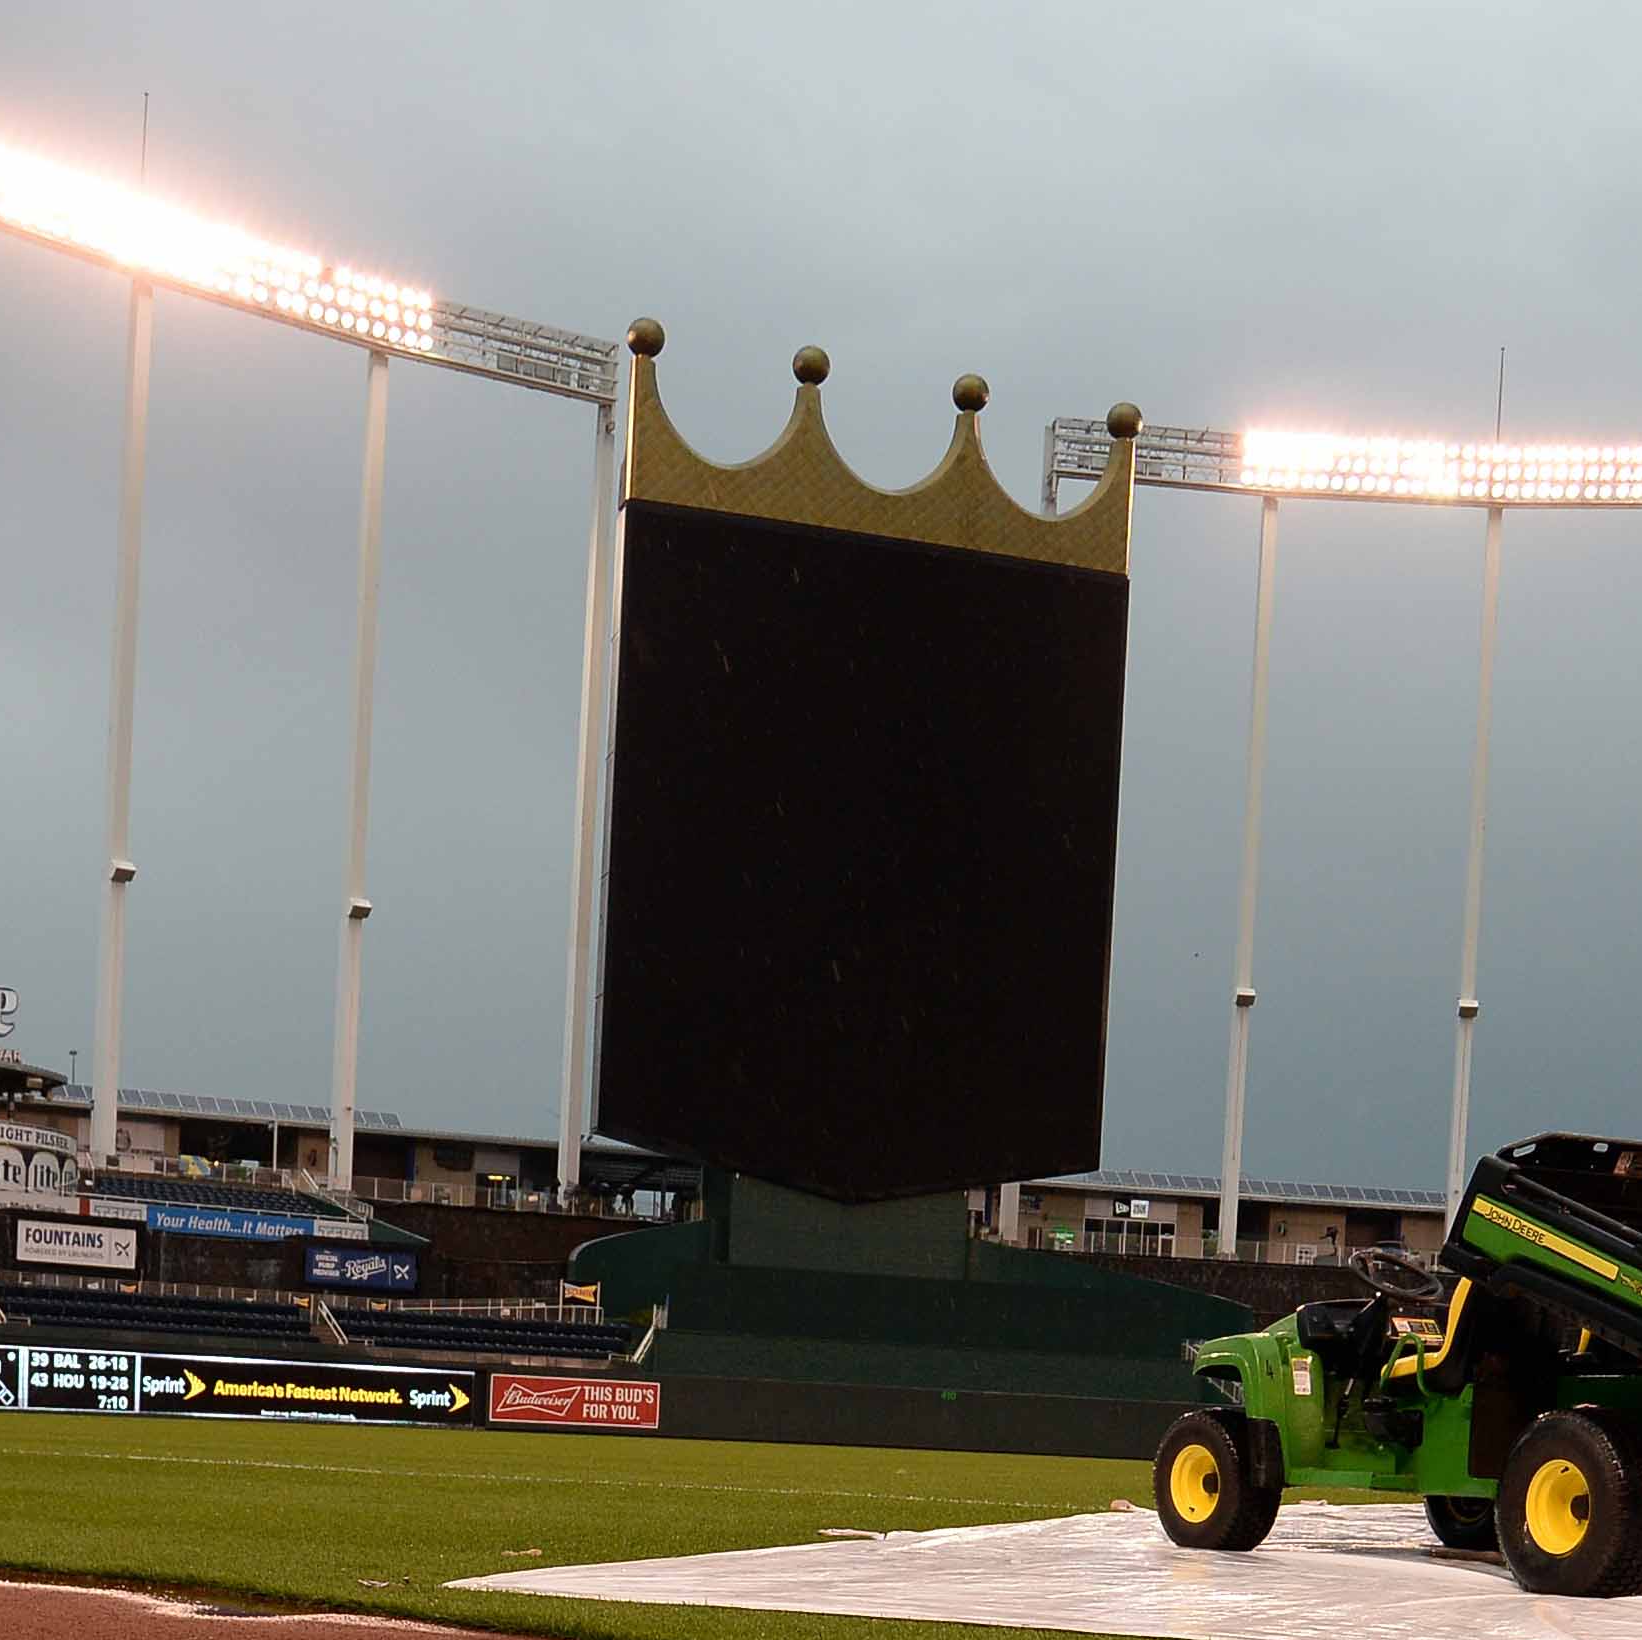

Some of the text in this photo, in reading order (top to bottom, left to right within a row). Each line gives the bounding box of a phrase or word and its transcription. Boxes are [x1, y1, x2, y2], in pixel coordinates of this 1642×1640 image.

[156, 1211, 184, 1229] Your
[1484, 1207, 1546, 1245] JOHN DEERE
[24, 1226, 104, 1249] FOUNTAINS
[341, 1255, 388, 1281] Royals
[30, 1351, 129, 1371] 39 BAL 26-18
[30, 1371, 129, 1392] 43 HOU 19-28
[97, 1394, 129, 1410] 7:10
[142, 1374, 451, 1410] Sprint America's Fastest Network. Sprint
[507, 1387, 573, 1407] Budweiser
[583, 1385, 655, 1404] THIS BUD'S
[582, 1403, 641, 1421] FOR YOU.
